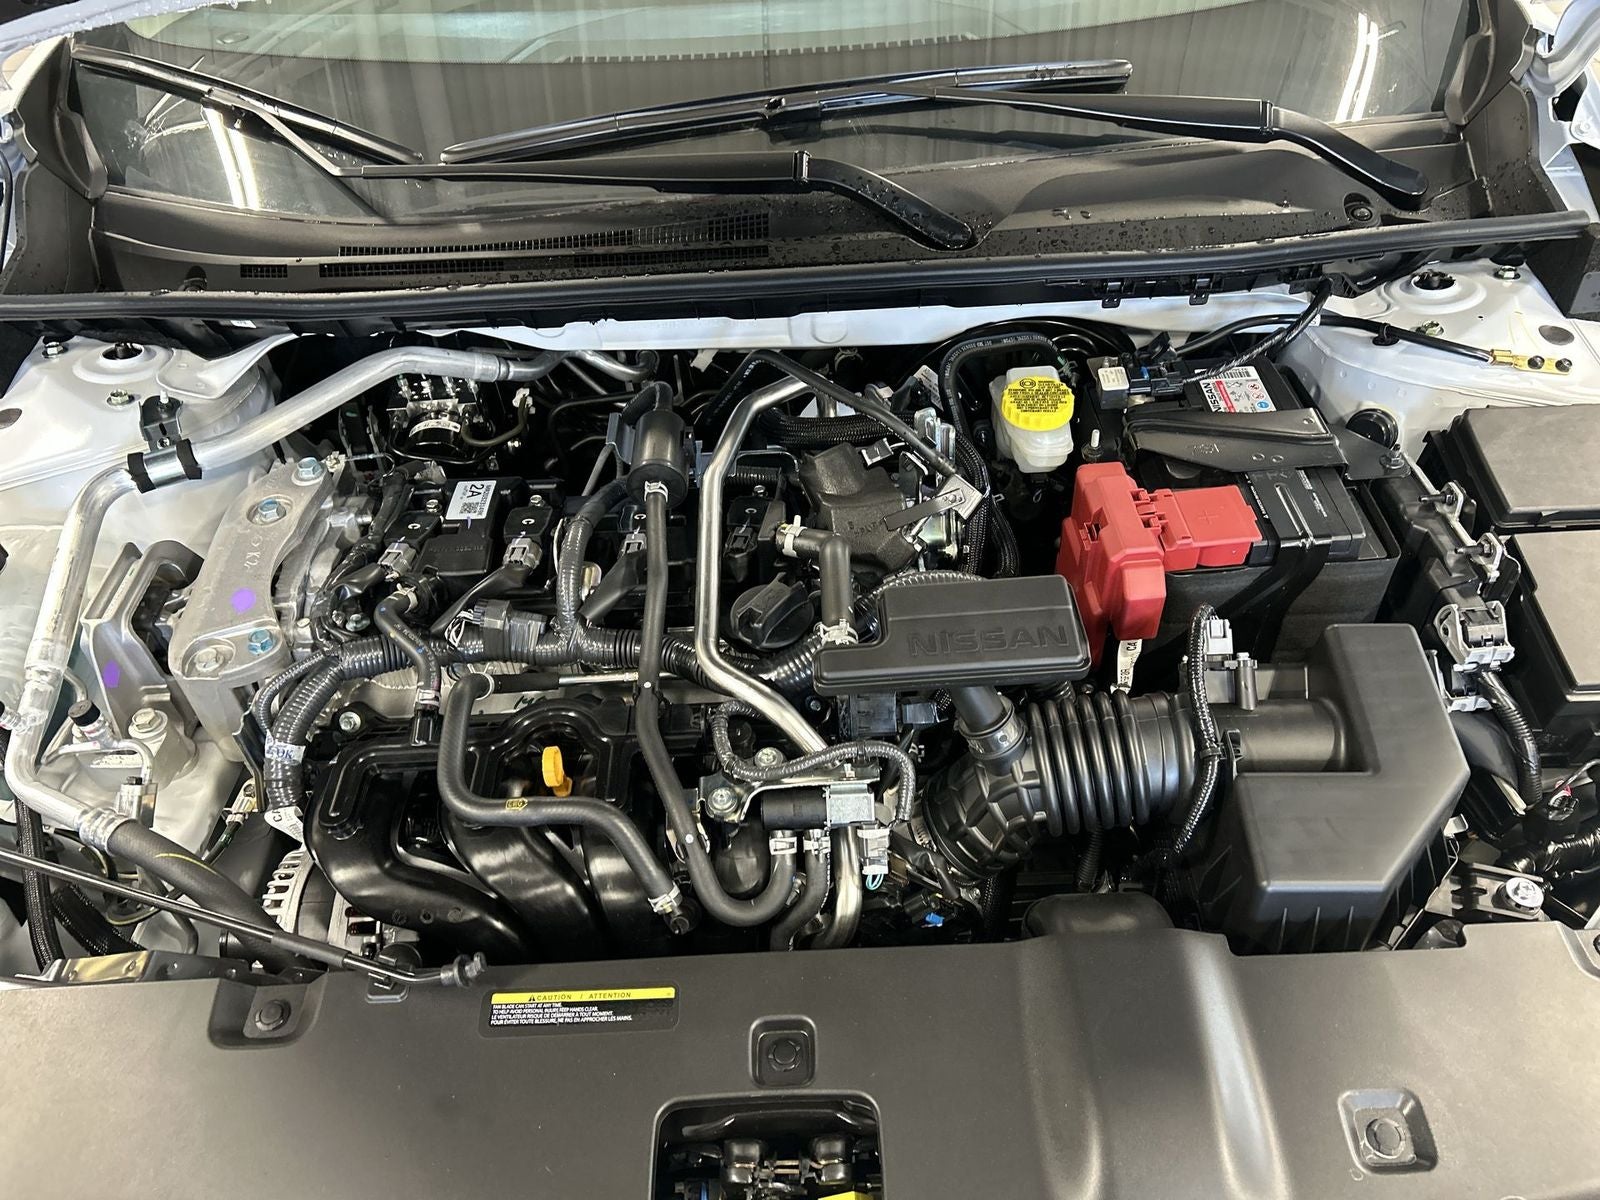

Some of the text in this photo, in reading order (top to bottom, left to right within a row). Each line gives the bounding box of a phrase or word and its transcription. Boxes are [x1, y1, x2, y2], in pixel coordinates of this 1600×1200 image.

[1202, 382, 1222, 412] NISSAN
[467, 483, 485, 499] 2A
[906, 624, 1070, 656] NISSAN
